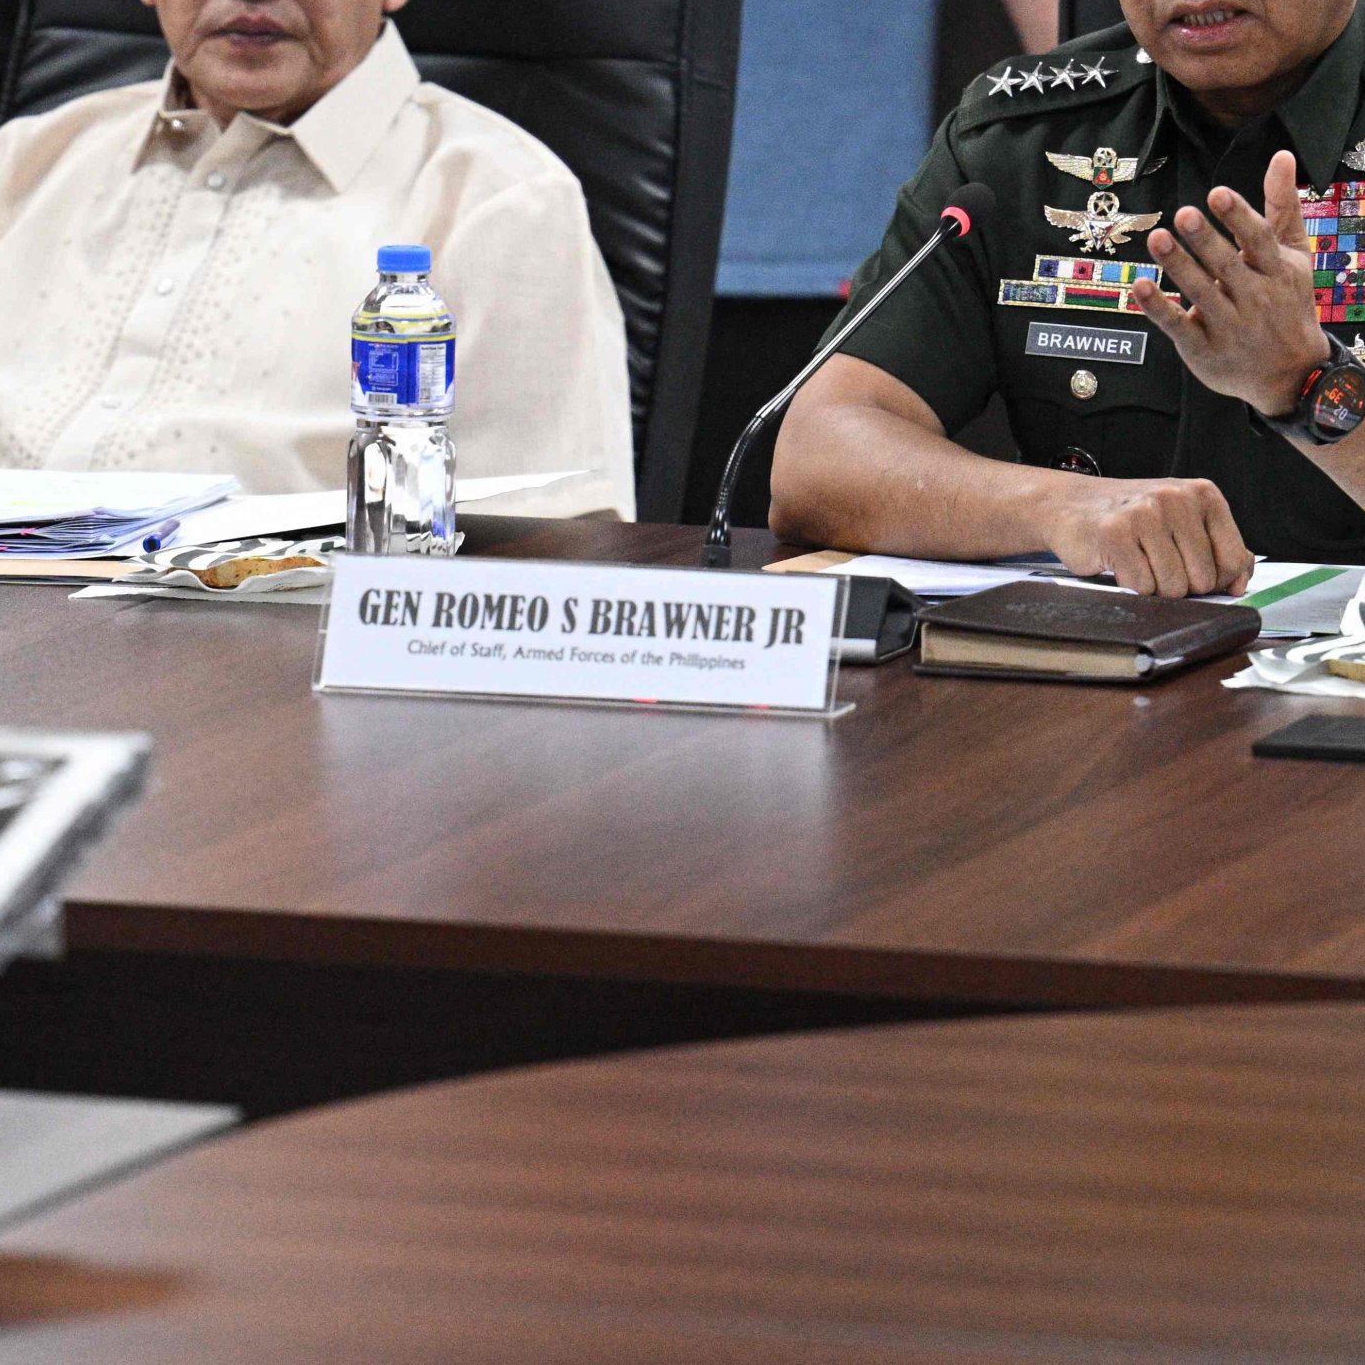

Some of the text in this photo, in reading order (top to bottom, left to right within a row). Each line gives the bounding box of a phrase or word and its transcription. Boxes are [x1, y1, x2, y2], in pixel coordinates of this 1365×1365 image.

[1037, 332, 1132, 355] BRAWNER
[359, 588, 807, 649] GEN ROMEO S BRAWNER JR
[407, 638, 746, 672] Chief of Staff, Armed Forces of the Philippines
